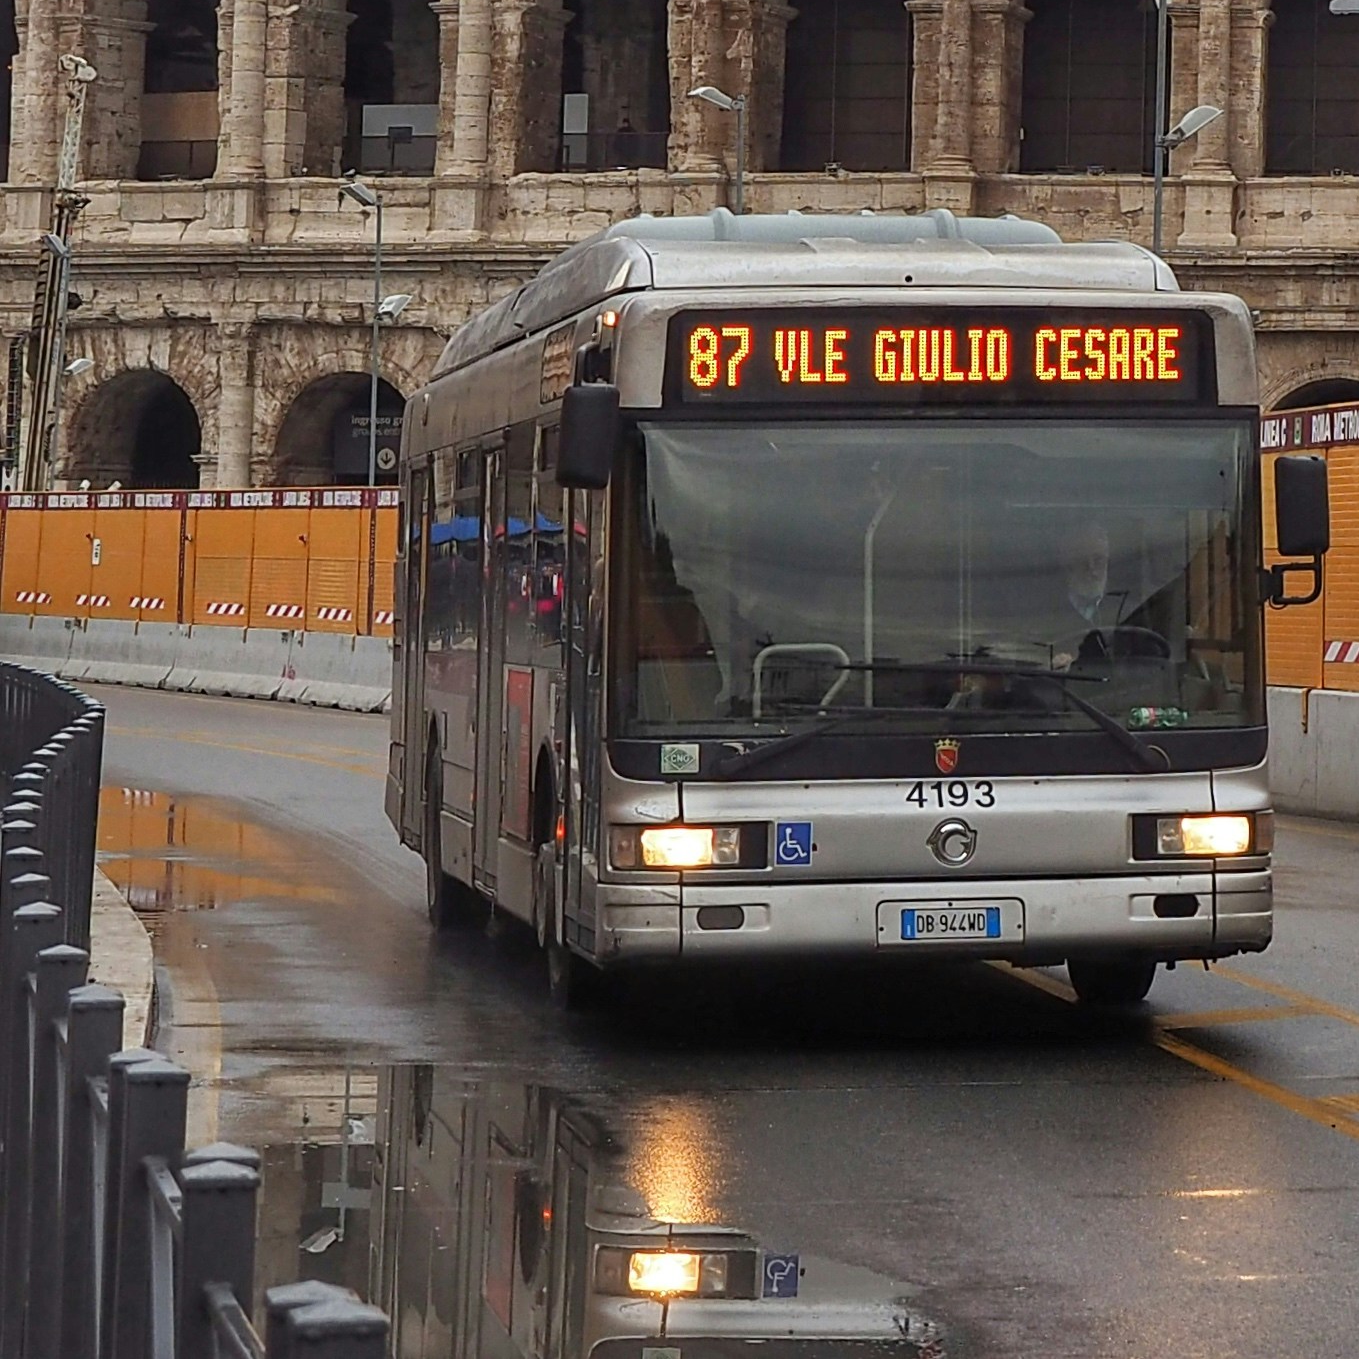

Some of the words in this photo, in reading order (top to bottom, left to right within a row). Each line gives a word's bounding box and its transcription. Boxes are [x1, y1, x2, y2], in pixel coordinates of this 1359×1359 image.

[689, 327, 750, 387] 87
[774, 329, 847, 383] VLE
[874, 329, 1009, 383] GIULIO
[1035, 328, 1180, 382] CESARE
[1281, 418, 1287, 446] C
[906, 780, 995, 808] 4193
[916, 915, 934, 934] DB
[940, 913, 985, 933] 944WD
